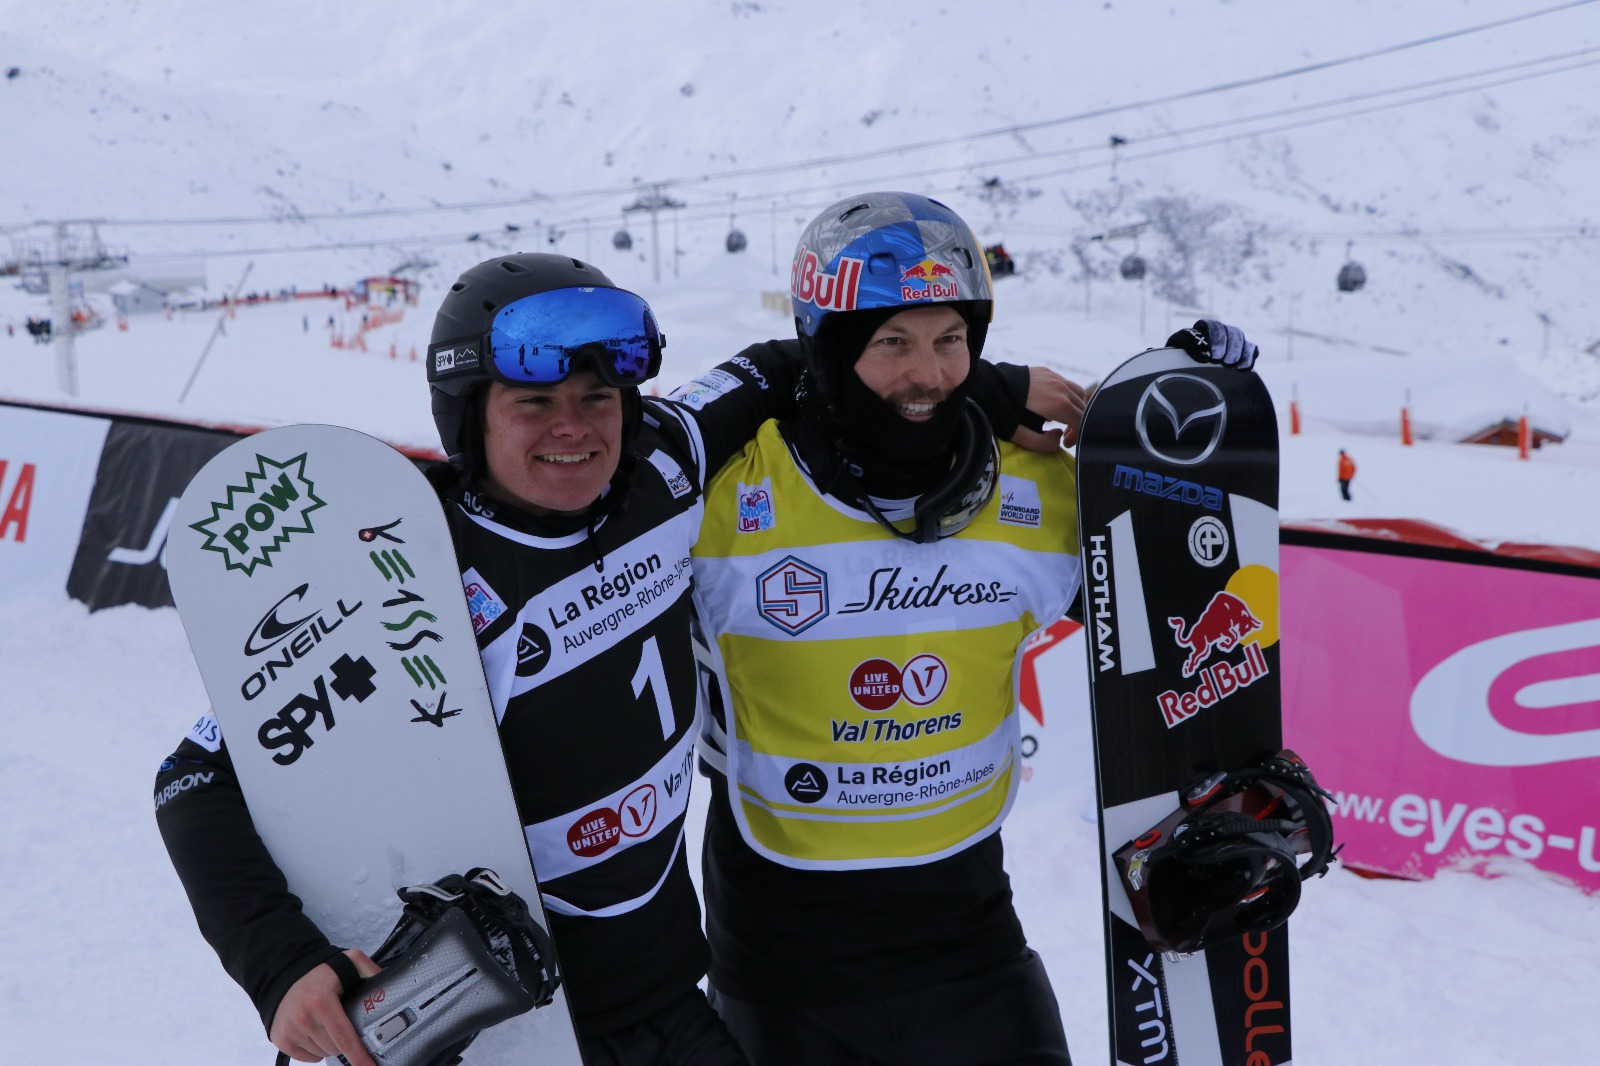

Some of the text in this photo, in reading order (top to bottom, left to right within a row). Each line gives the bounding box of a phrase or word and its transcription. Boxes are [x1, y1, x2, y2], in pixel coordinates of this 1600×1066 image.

[799, 250, 864, 310] Bull
[901, 282, 959, 300] Red Bull
[223, 472, 300, 555] POW
[1000, 510, 1024, 520] WORLD
[1001, 504, 1040, 515] SNOWBOARD
[549, 553, 662, 630] La Région
[837, 564, 1006, 614] Skidress
[1090, 535, 1115, 672] HOTHAM
[631, 635, 676, 742] 1
[853, 684, 900, 696] UNITED
[864, 672, 889, 683] LIVE
[1156, 640, 1270, 730] Red Bull
[257, 674, 336, 766] SPY
[831, 711, 963, 743] Val Thorens
[836, 762, 995, 806] Auvergne-Rhône-Alpes
[837, 759, 951, 787] La Région
[571, 826, 620, 851] UNITED
[580, 817, 607, 835] LIVE
